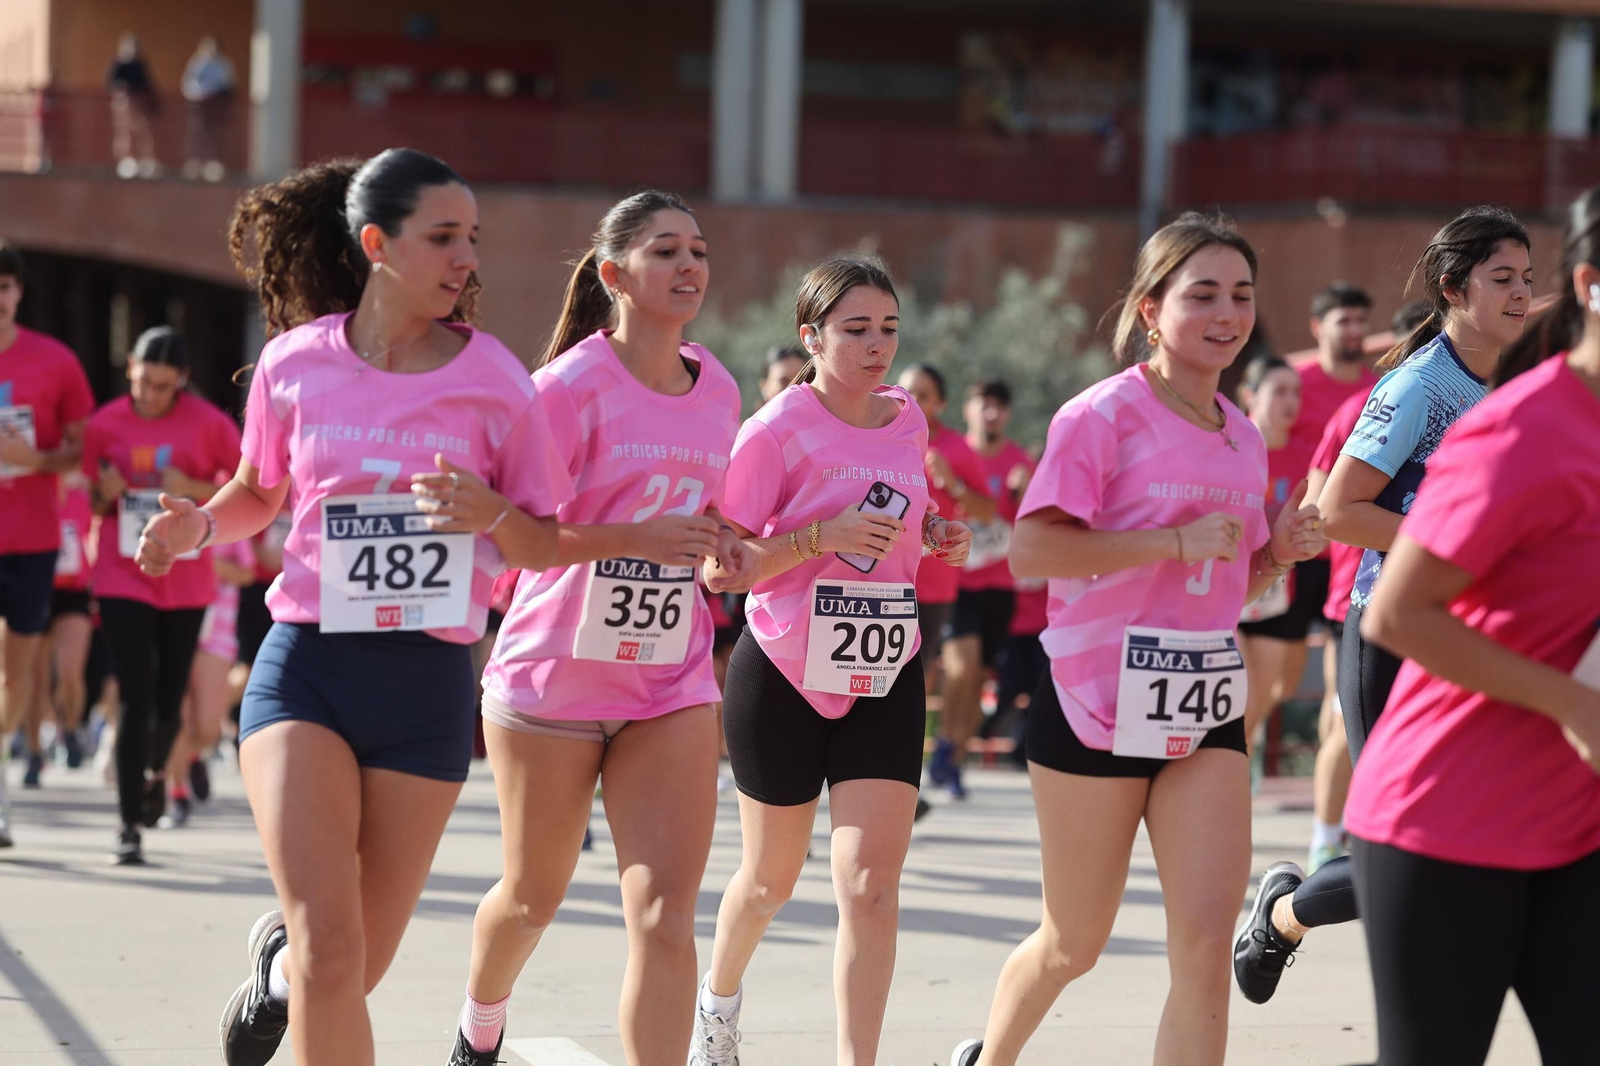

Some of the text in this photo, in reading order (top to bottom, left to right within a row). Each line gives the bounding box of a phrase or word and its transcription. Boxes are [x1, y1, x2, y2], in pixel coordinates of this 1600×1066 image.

[367, 427, 396, 445] POR
[401, 430, 418, 448] EL
[612, 442, 667, 459] MÉDICAS
[670, 446, 690, 462] POR
[693, 449, 703, 465] EL
[360, 456, 402, 495] 7
[822, 465, 873, 480] MÉDICAS
[877, 469, 896, 483] POR
[899, 472, 909, 486] EL
[632, 474, 705, 523] 22
[1148, 480, 1204, 500] MÉDICAS
[1209, 487, 1228, 502] POR
[1230, 490, 1241, 505] EL
[329, 517, 396, 537] UMA
[348, 542, 450, 590] 482
[600, 559, 653, 579] UMA
[376, 608, 402, 625] WE
[604, 585, 682, 630] 356
[819, 598, 873, 616] UMA
[619, 644, 639, 658] WE
[831, 622, 905, 664] 209
[1130, 649, 1195, 670] UMA
[851, 678, 871, 690] WE
[1147, 677, 1232, 722] 146
[1168, 739, 1190, 754] WE
